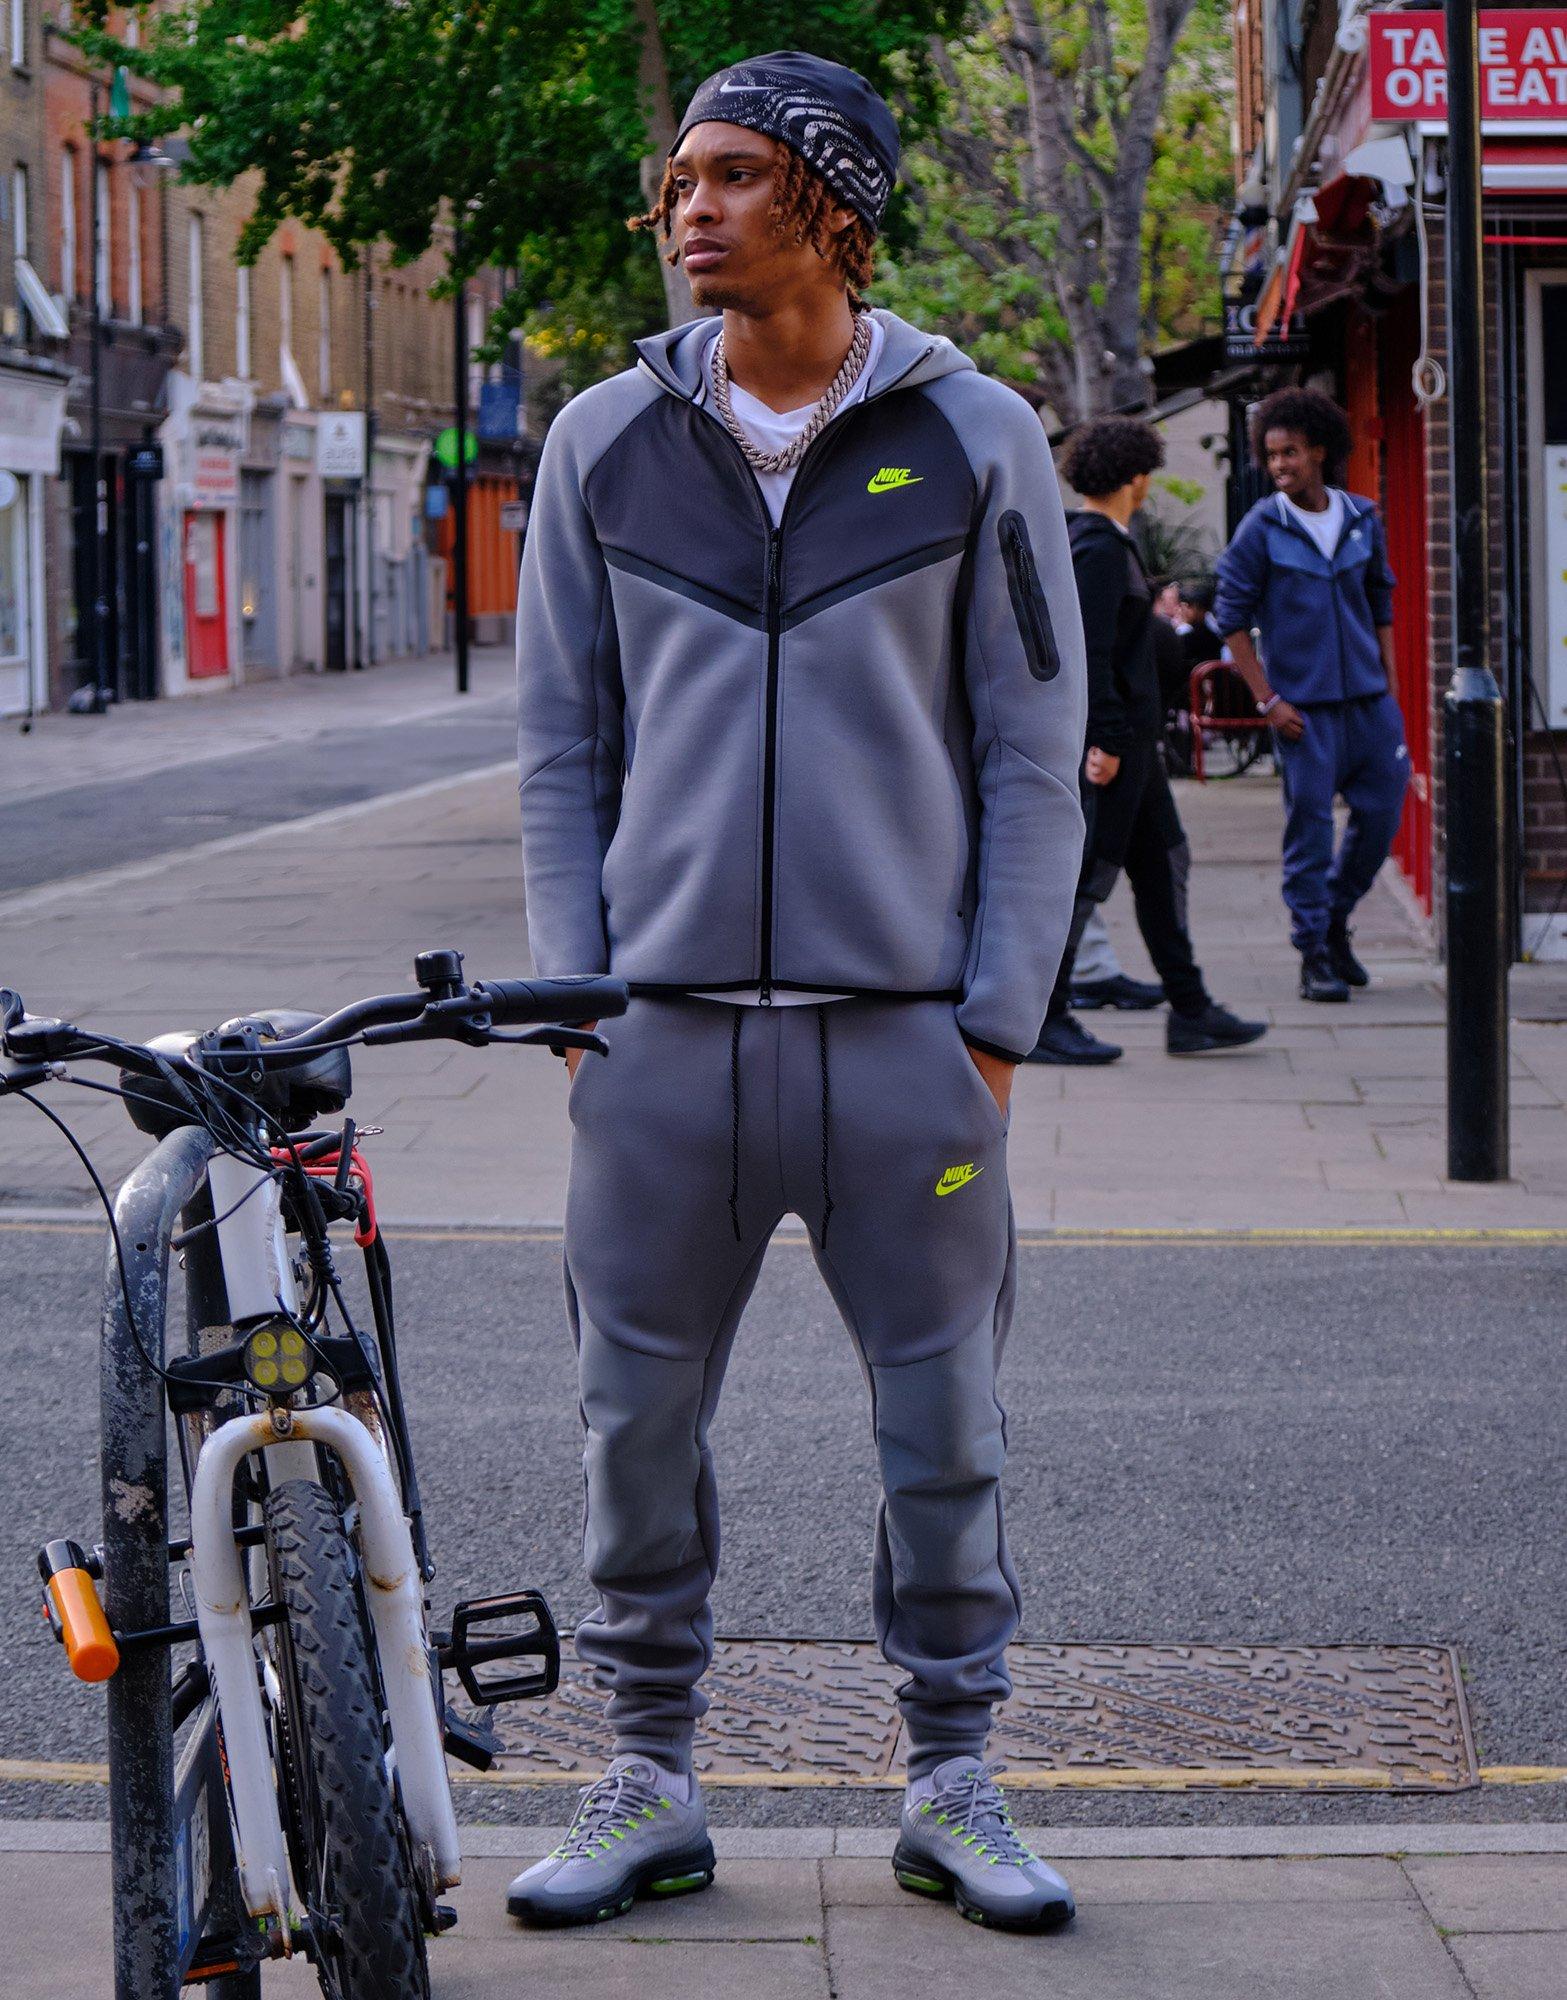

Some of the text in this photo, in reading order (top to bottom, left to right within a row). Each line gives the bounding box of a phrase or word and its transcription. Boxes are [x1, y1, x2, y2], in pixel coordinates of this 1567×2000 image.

[1382, 27, 1509, 65] TAE
[875, 467, 911, 482] NIKE
[942, 1162, 974, 1183] NIKE
